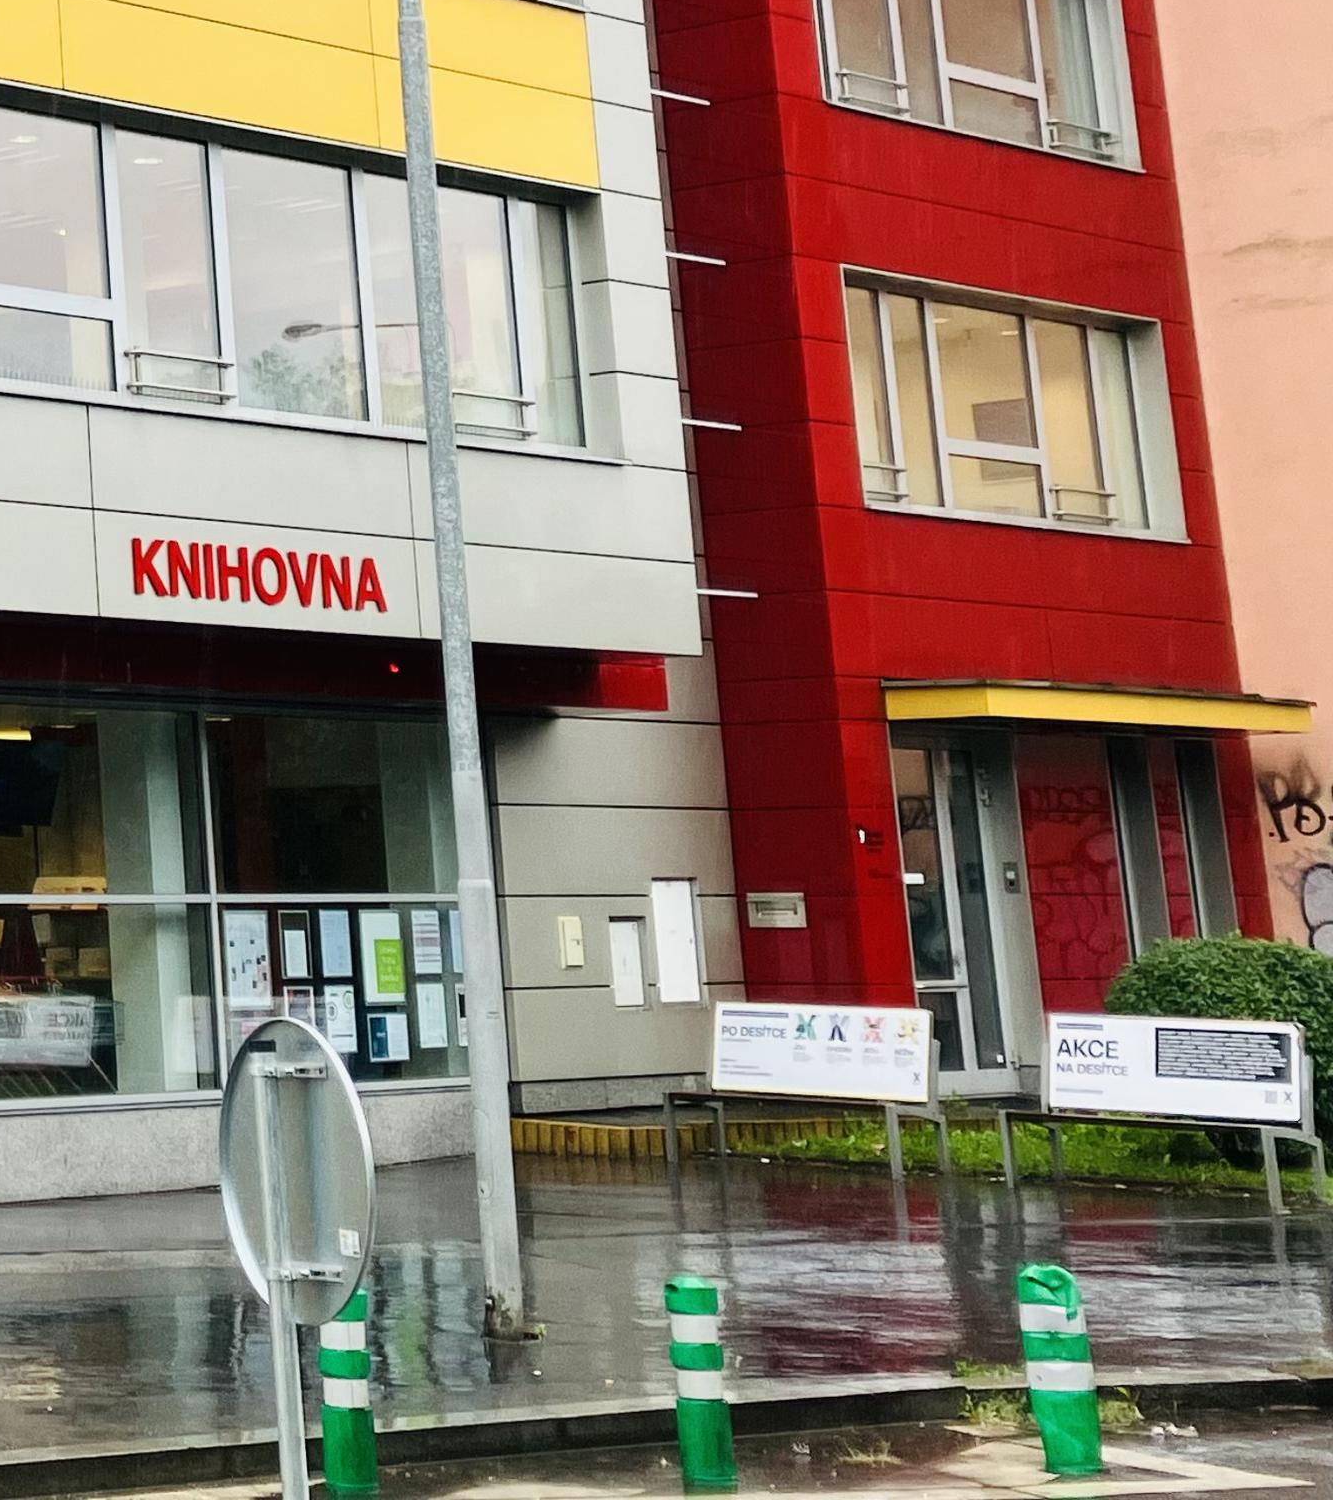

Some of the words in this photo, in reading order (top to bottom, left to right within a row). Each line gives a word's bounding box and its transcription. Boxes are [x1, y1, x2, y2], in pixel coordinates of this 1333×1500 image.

[131, 537, 388, 613] KNIHOVNA
[721, 1026, 737, 1038] PO
[741, 1025, 786, 1039] DESÍTCE
[1056, 1039, 1120, 1060] AKCE
[1056, 1062, 1076, 1075] NA
[1079, 1062, 1129, 1077] DESÍTCE
